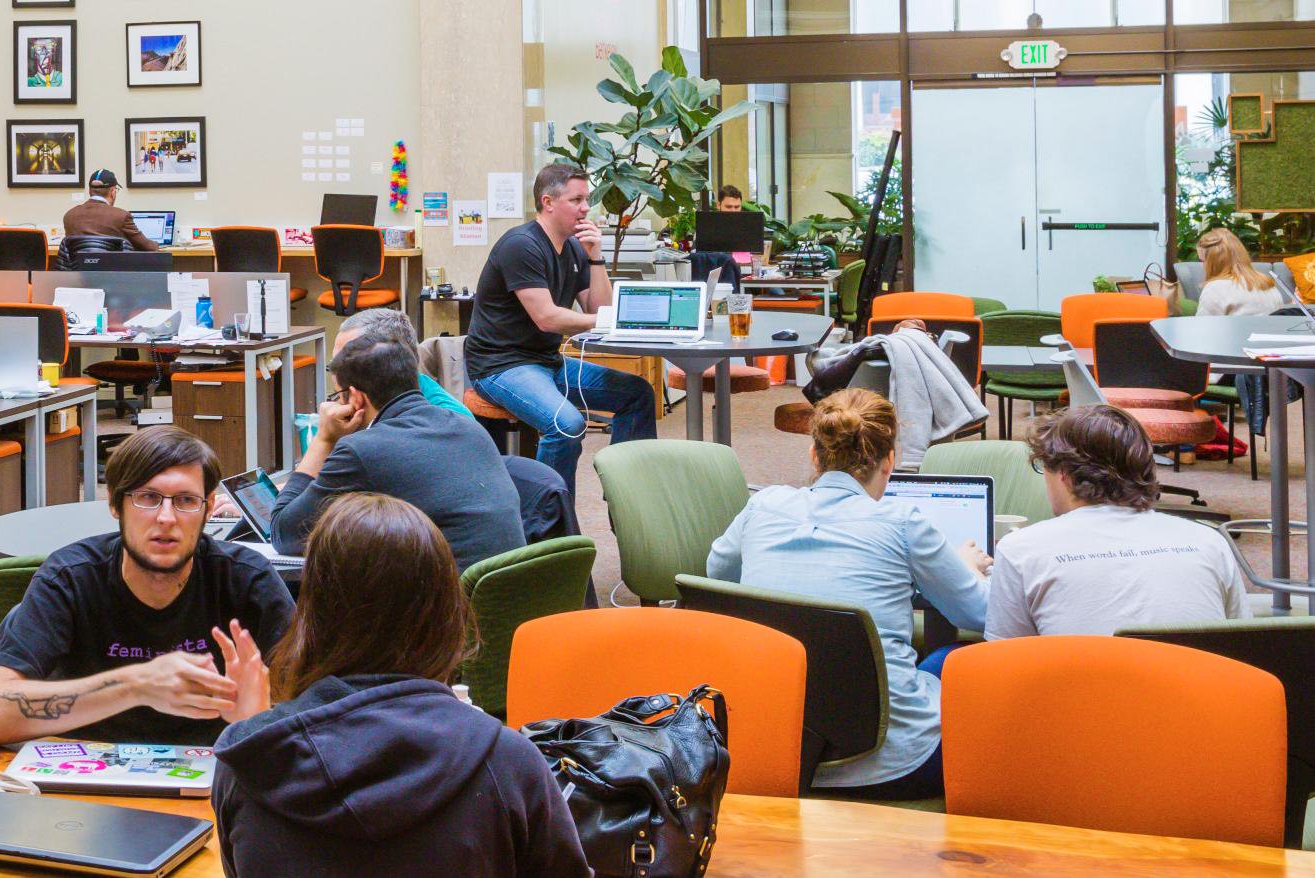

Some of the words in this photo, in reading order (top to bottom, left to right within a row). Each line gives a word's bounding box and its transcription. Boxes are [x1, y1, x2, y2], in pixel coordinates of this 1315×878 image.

[1021, 45, 1048, 64] EXIT
[1055, 553, 1086, 563] When
[1088, 550, 1117, 560] words
[1119, 549, 1138, 557] fail,
[1140, 546, 1168, 556] music
